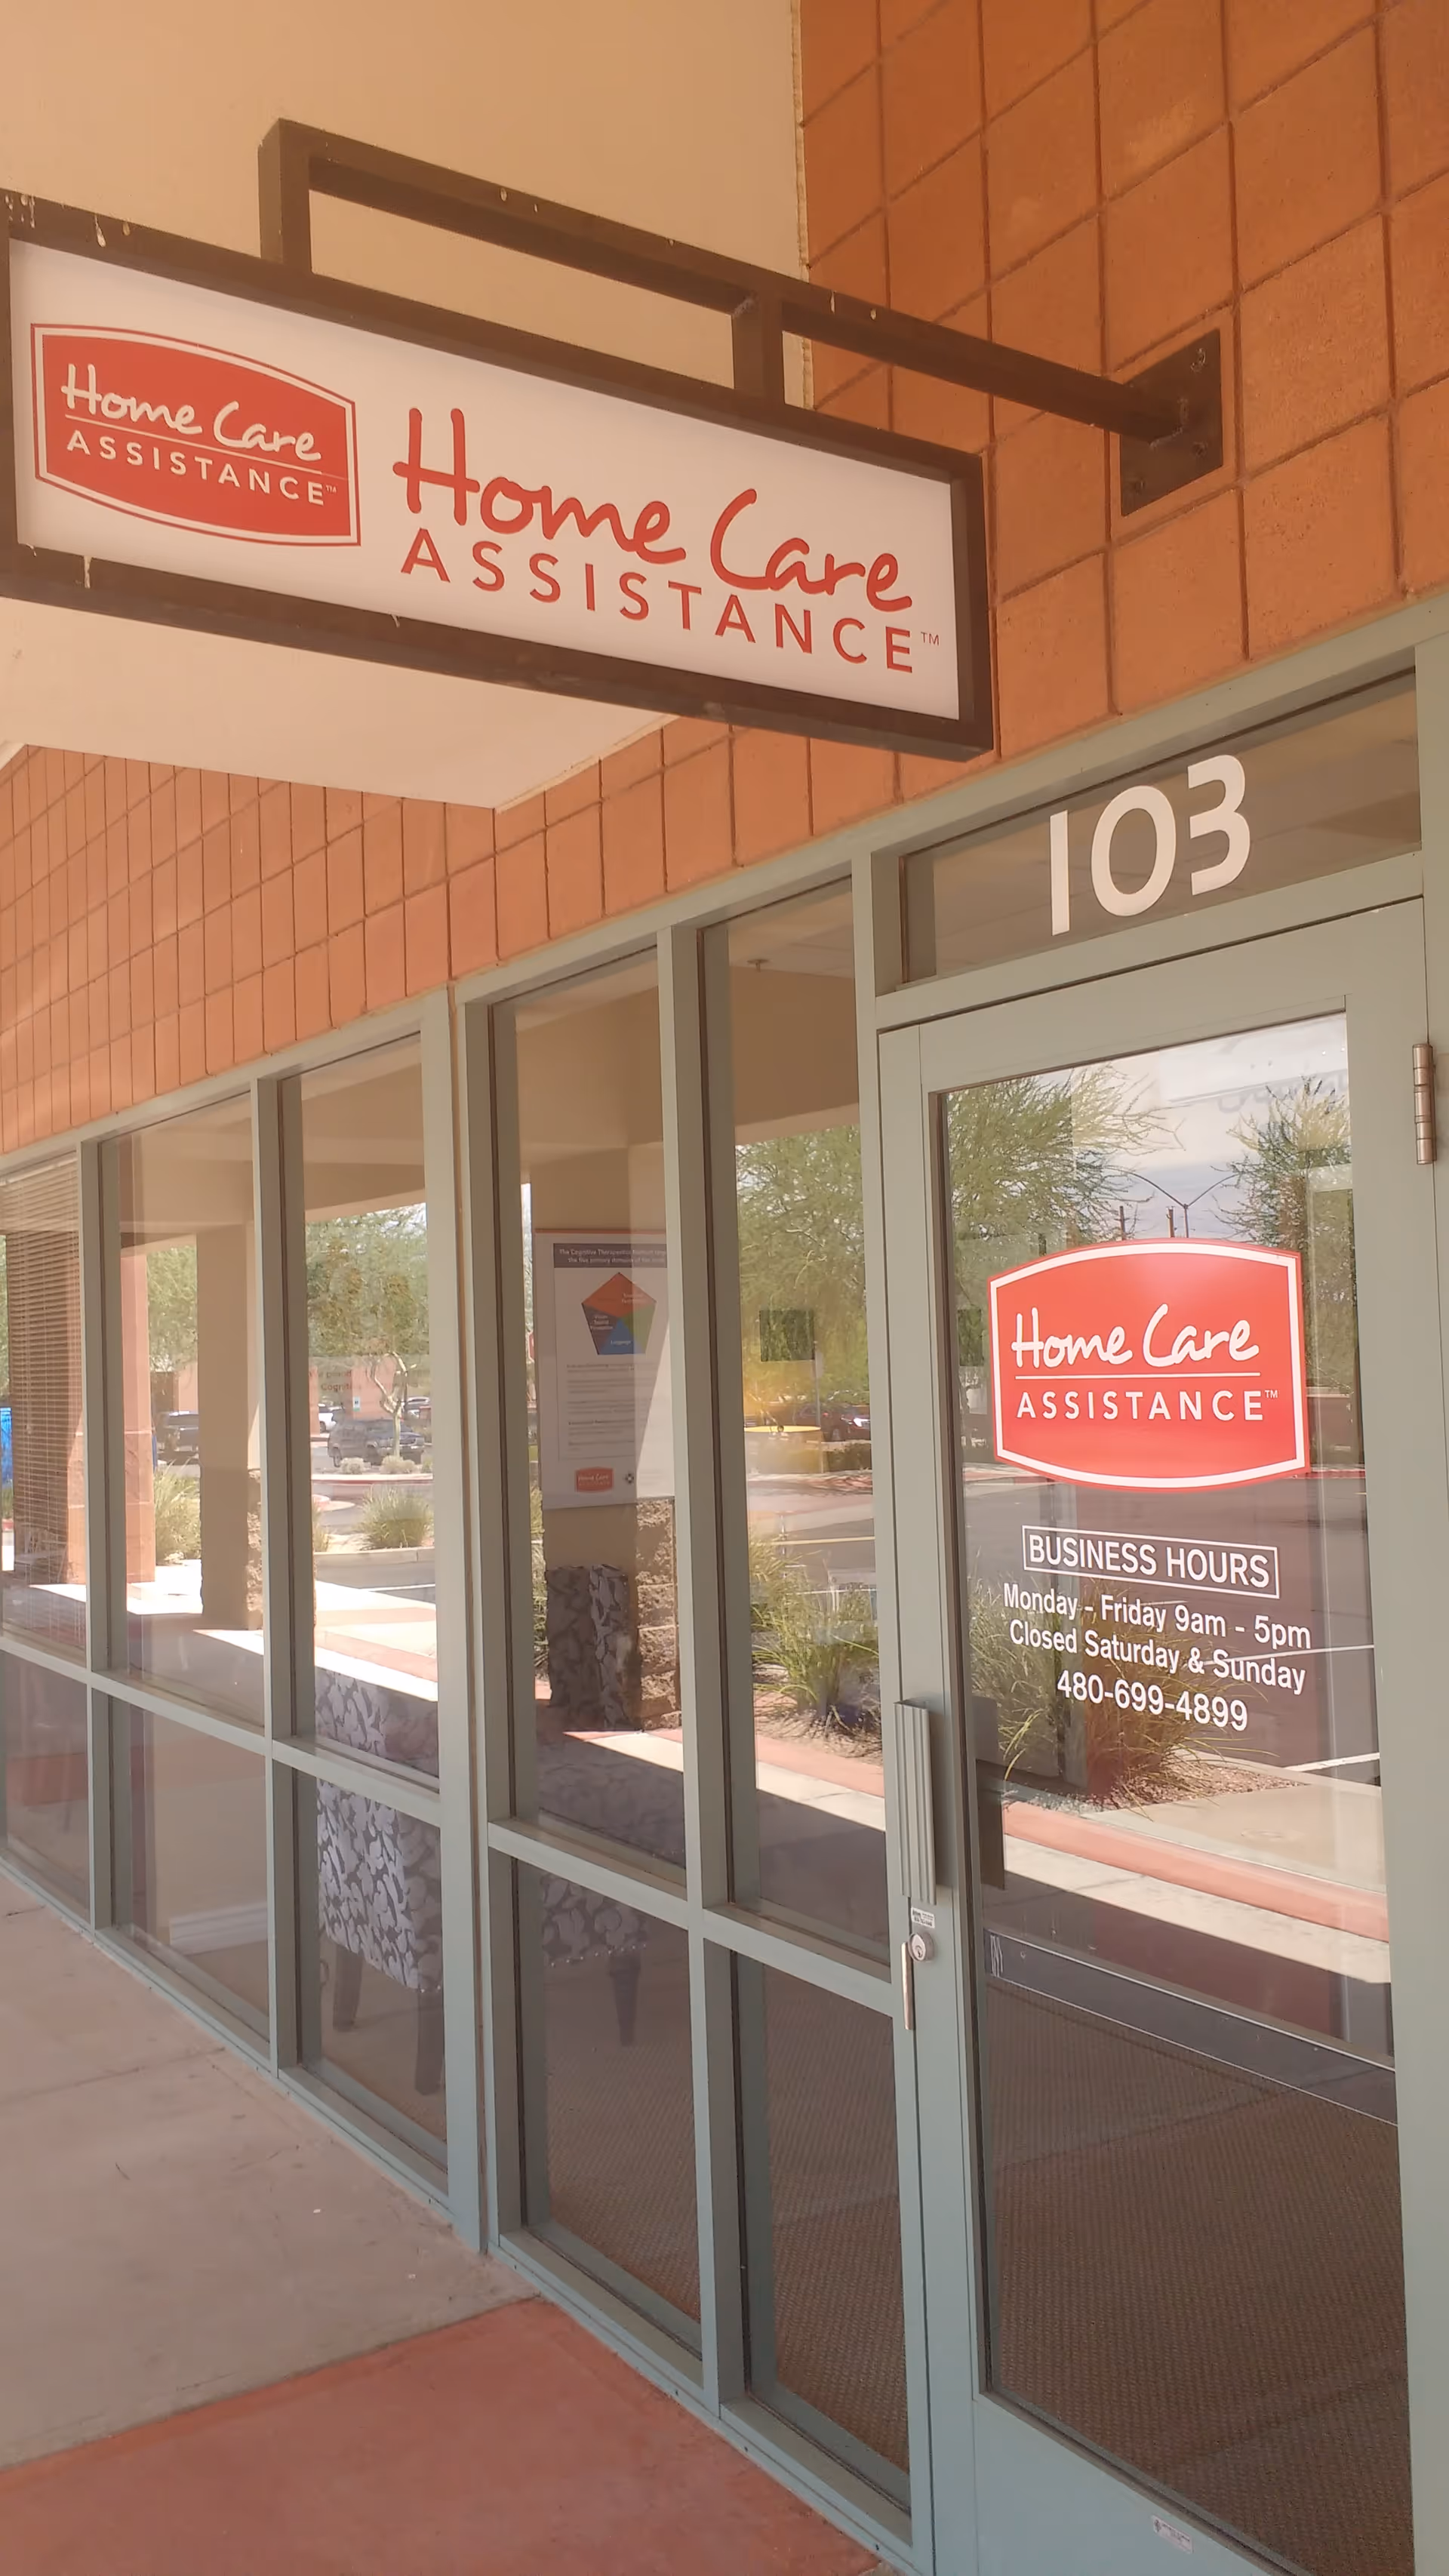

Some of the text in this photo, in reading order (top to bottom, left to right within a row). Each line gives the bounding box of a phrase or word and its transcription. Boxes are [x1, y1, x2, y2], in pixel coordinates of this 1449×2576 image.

[61, 363, 322, 461] Home Care
[66, 430, 325, 506] ASSISTANCE
[392, 408, 912, 612] Home Care
[401, 528, 913, 673] ASSISTANCE
[1049, 754, 1251, 936] 103
[1011, 1303, 1260, 1368] Home Care
[1017, 1390, 1264, 1421] ASSISTANCE
[1029, 1534, 1269, 1588] BUSINESS HOURS
[1004, 1583, 1078, 1620] Monday
[1101, 1594, 1167, 1633] Friday
[1174, 1605, 1226, 1637] 9am
[1254, 1615, 1312, 1649] 5pm
[1010, 1619, 1306, 1695] Closed Saturday & Sunday
[1057, 1670, 1248, 1731] 480-699-4899
